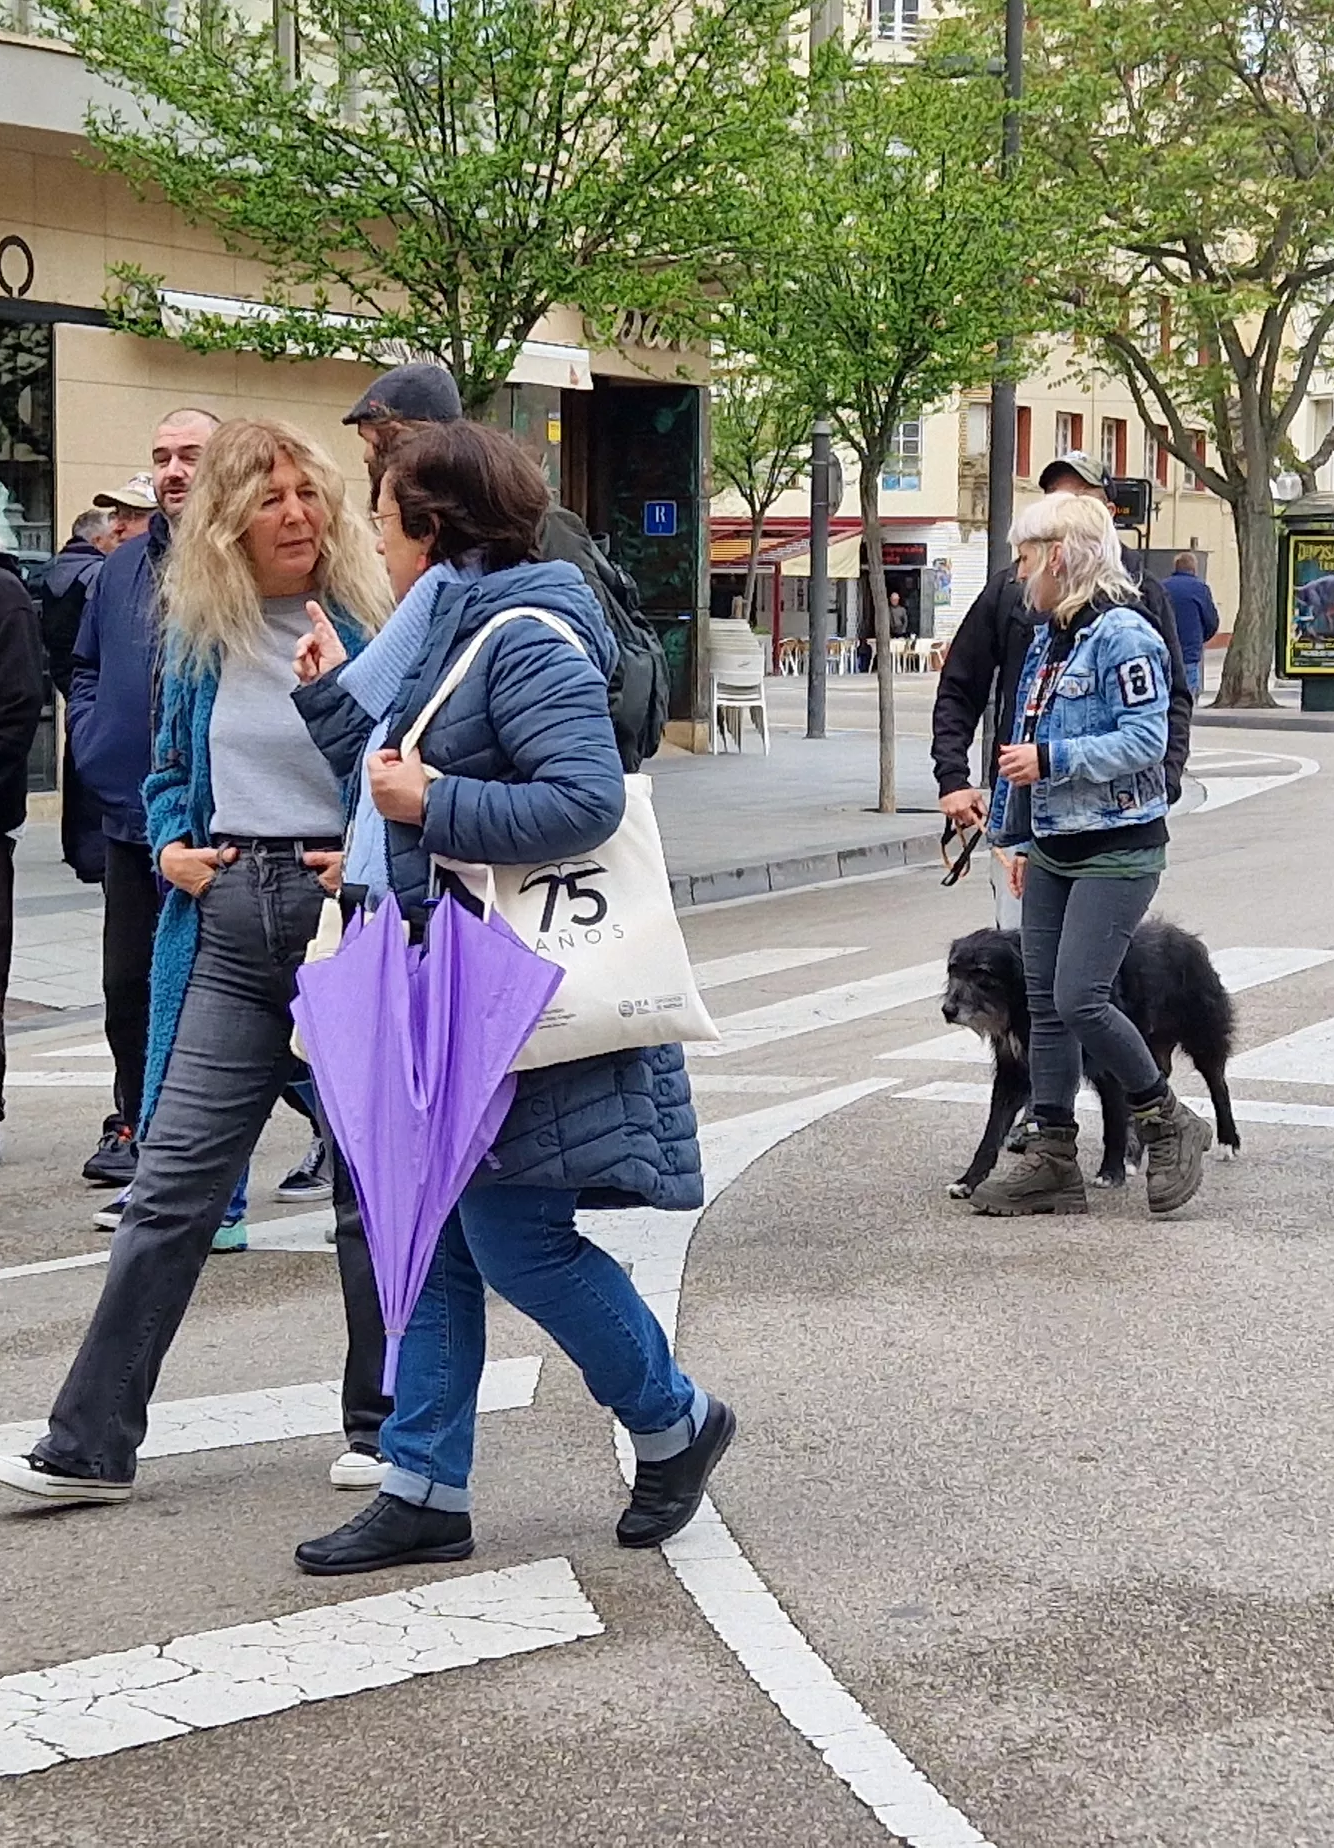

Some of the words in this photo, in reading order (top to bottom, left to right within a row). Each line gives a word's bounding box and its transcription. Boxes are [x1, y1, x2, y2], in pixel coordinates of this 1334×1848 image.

[655, 505, 667, 523] R
[518, 863, 608, 933] 75
[534, 924, 624, 955] AÑOS
